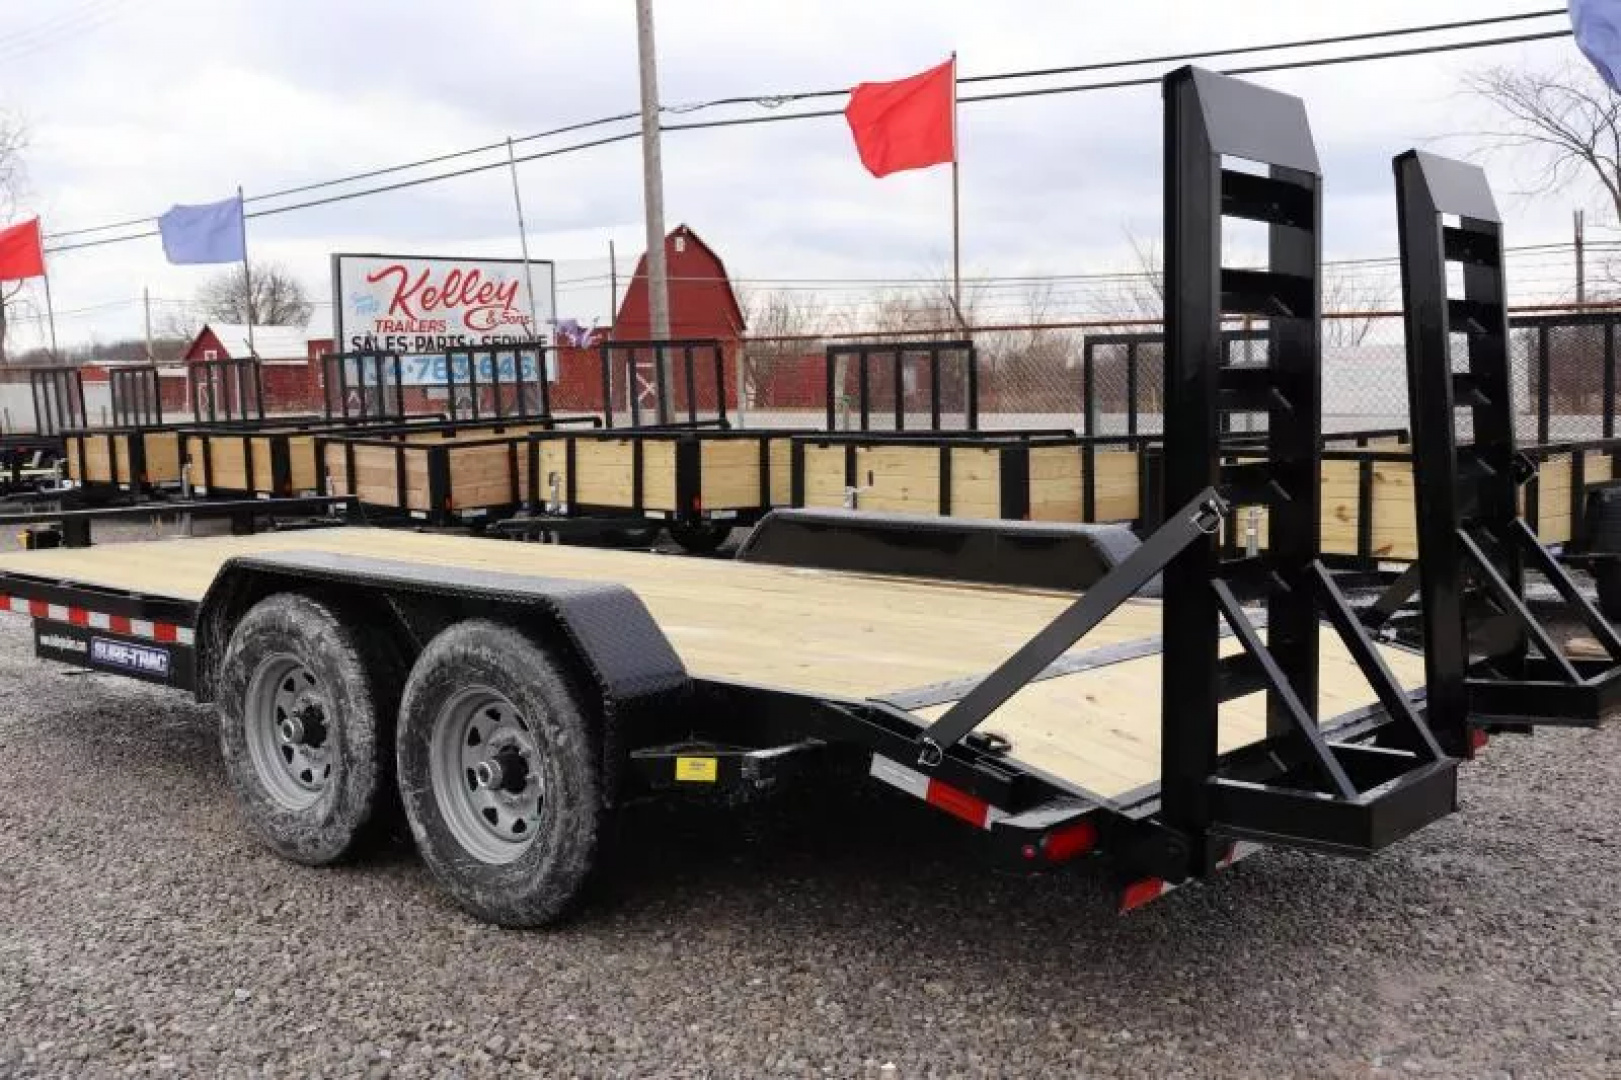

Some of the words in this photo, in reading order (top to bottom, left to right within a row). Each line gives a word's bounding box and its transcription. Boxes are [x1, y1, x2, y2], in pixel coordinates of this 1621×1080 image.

[366, 265, 520, 321] Kelley
[500, 311, 531, 325] Sons
[375, 319, 447, 333] TRAILERS
